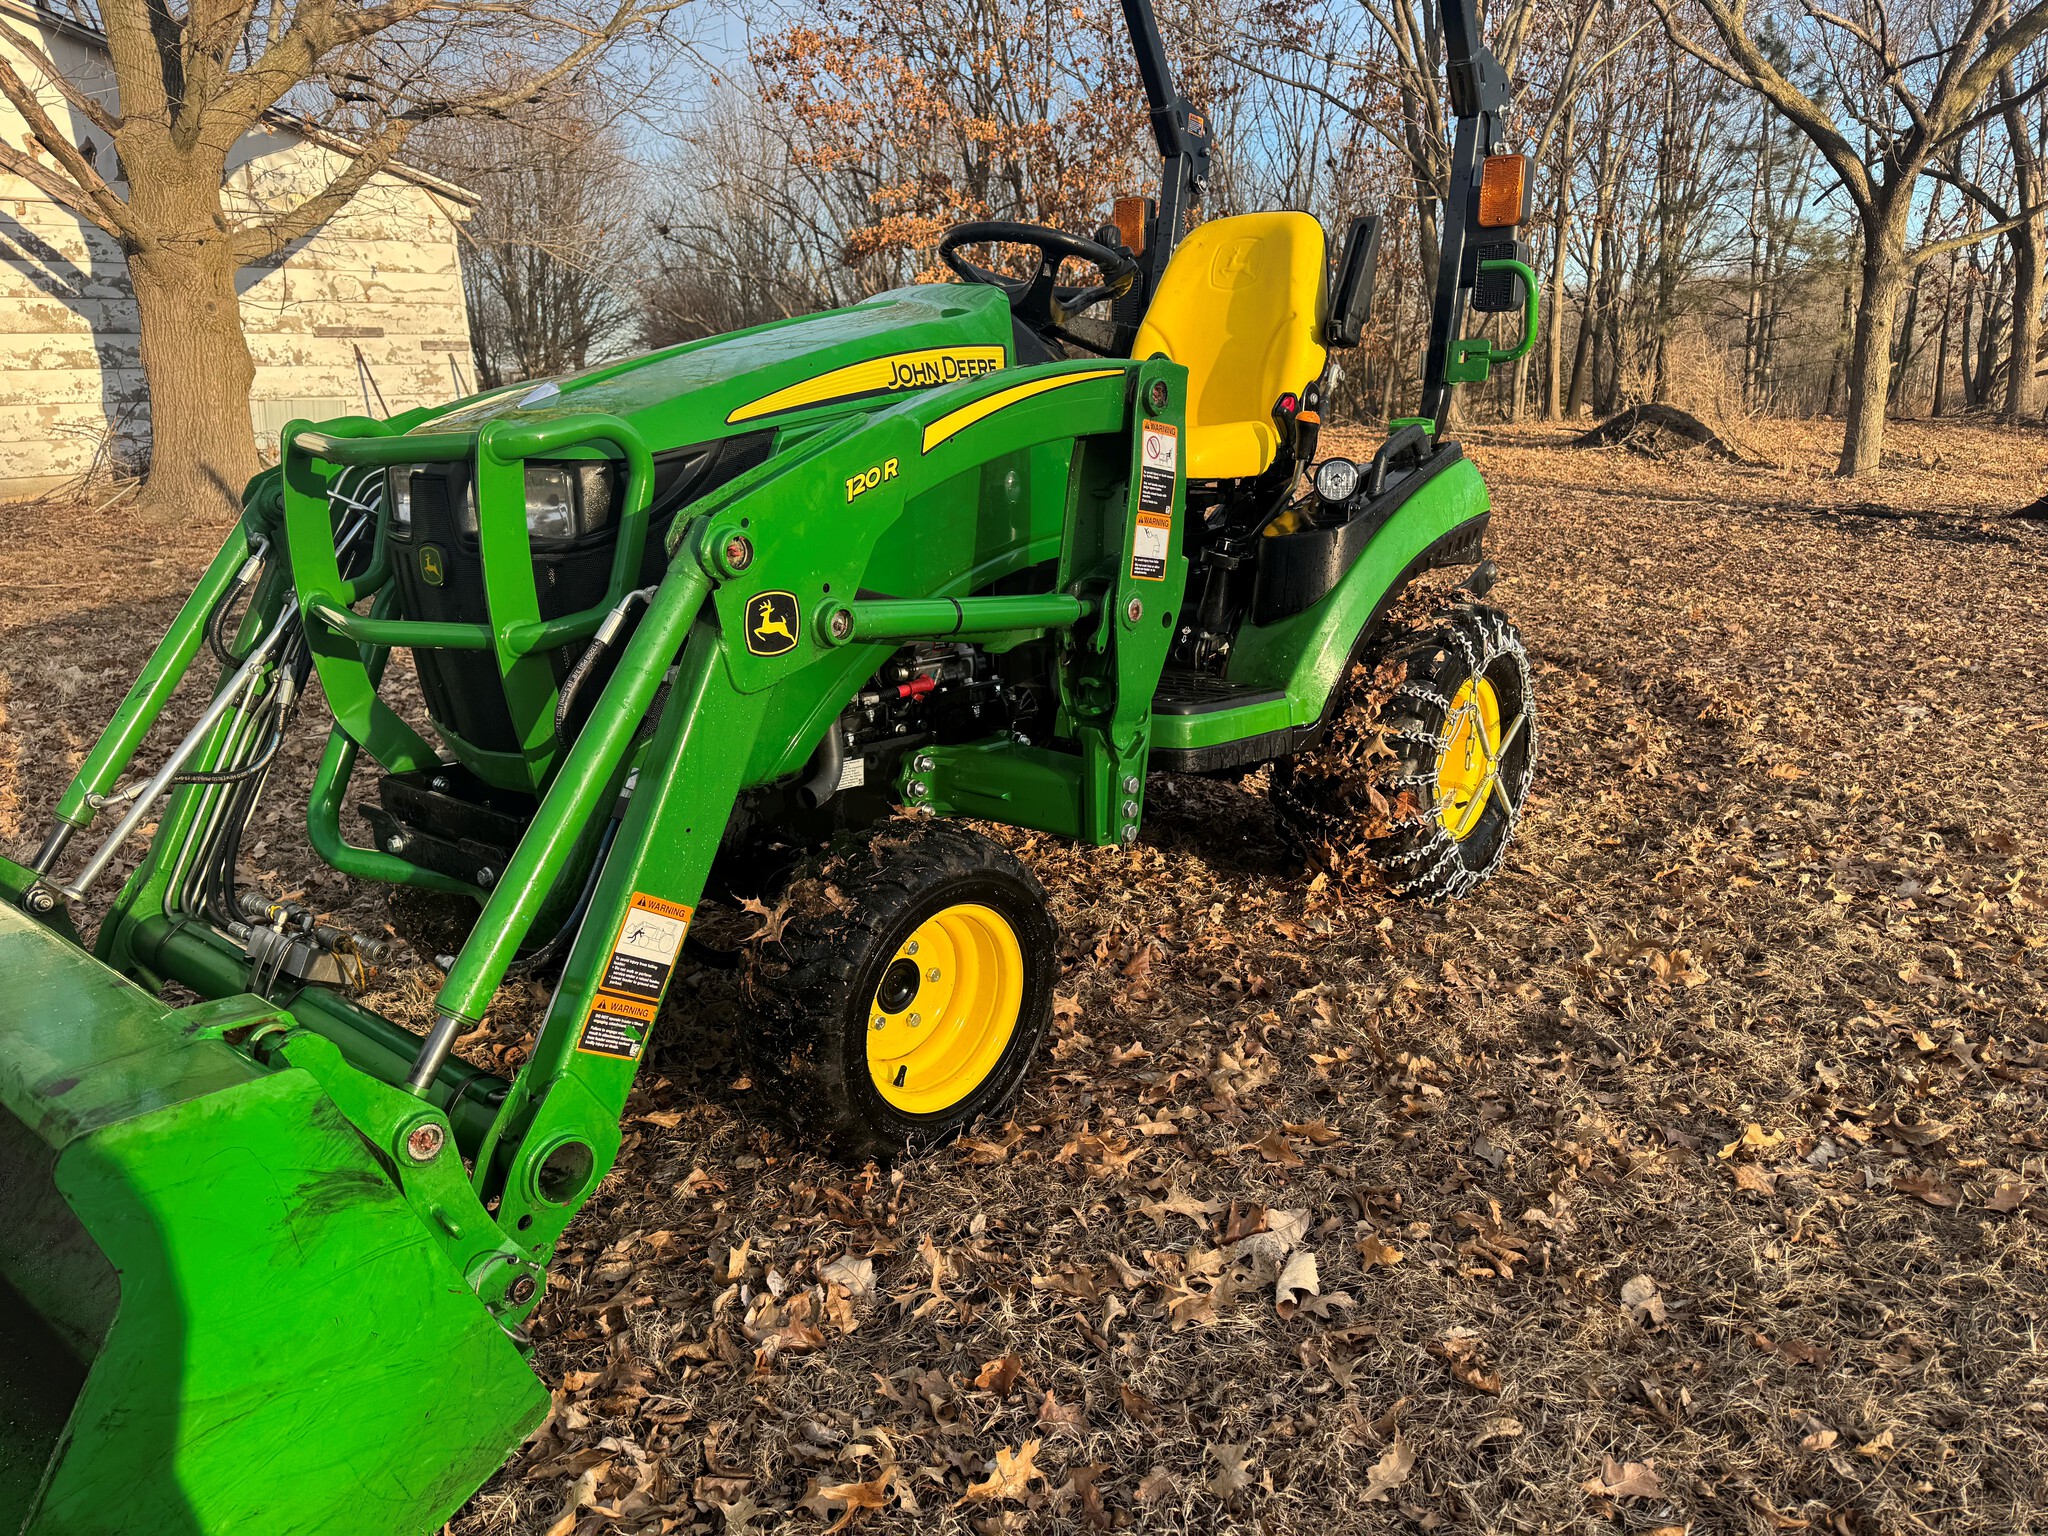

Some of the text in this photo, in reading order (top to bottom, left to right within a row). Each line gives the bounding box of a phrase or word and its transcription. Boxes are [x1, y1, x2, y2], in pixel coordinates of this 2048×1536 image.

[888, 361, 941, 387] JOHN
[1150, 423, 1176, 435] WARNING
[846, 457, 898, 504] 120 R
[1144, 516, 1169, 528] WARNING
[648, 900, 686, 918] WARNING
[610, 1002, 649, 1018] WARNING
